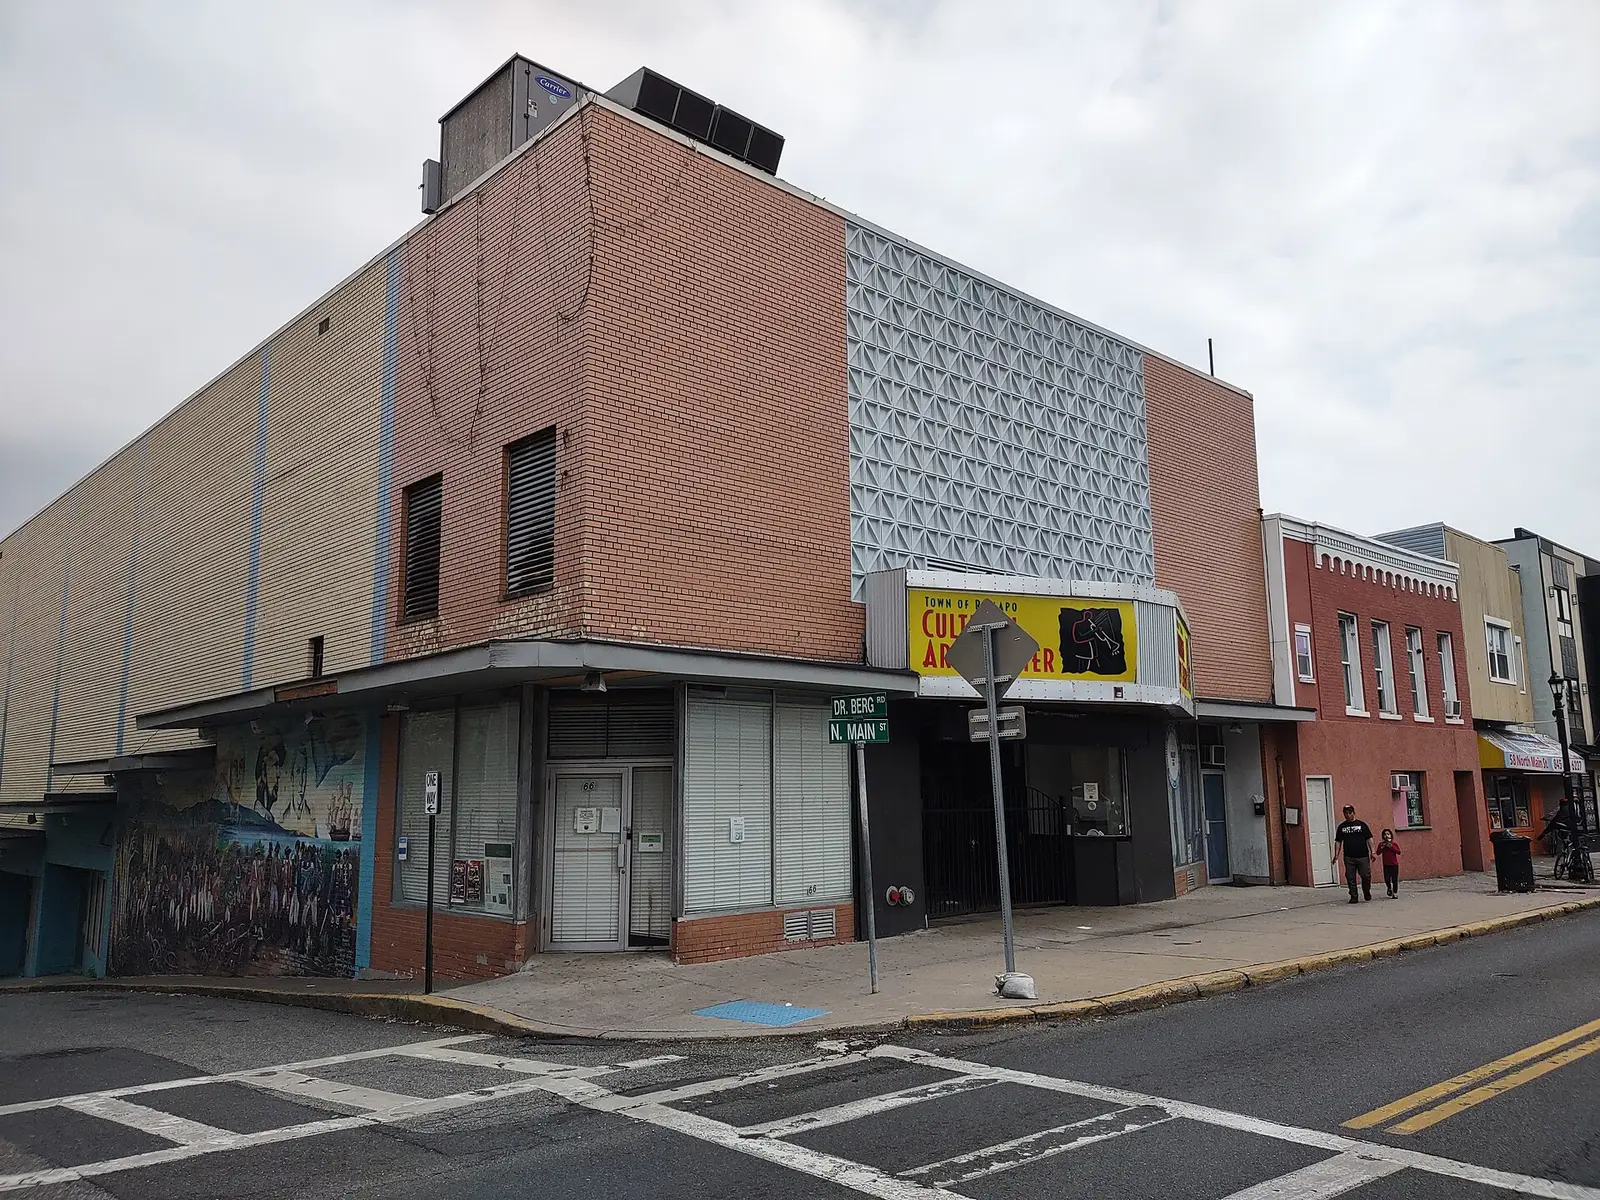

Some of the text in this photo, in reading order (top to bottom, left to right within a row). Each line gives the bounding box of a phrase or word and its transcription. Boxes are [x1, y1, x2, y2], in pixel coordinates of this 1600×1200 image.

[540, 78, 567, 95] Carrier
[924, 596, 1018, 612] TOWN OF RAPO
[833, 696, 886, 716] DR. BERG RD
[830, 722, 887, 741] N. MAIN ST
[1516, 754, 1530, 767] North
[1531, 756, 1543, 768] Main
[426, 773, 437, 787] ONE
[583, 781, 595, 791] 66
[426, 791, 437, 804] WAY
